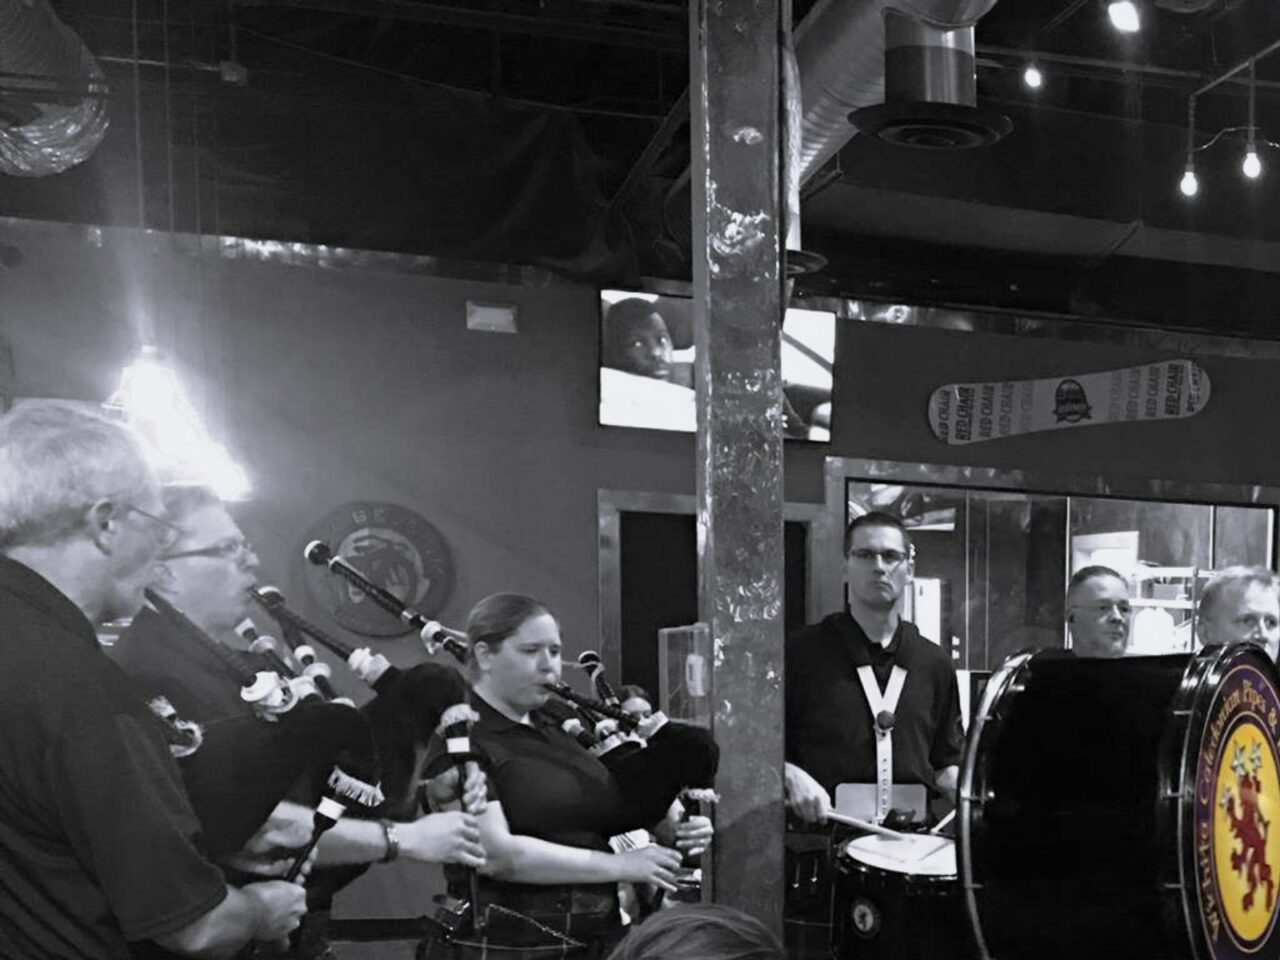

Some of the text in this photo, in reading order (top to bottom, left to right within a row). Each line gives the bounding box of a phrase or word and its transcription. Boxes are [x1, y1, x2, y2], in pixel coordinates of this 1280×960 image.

[1146, 366, 1160, 417] RED CHAIR
[1167, 364, 1180, 394] CHAIR
[957, 387, 970, 418] CHAIR
[979, 385, 994, 437] RED CHAIR
[1165, 395, 1177, 415] RED
[955, 419, 969, 440] RED
[1242, 679, 1267, 713] Pipes
[1267, 708, 1279, 735] &
